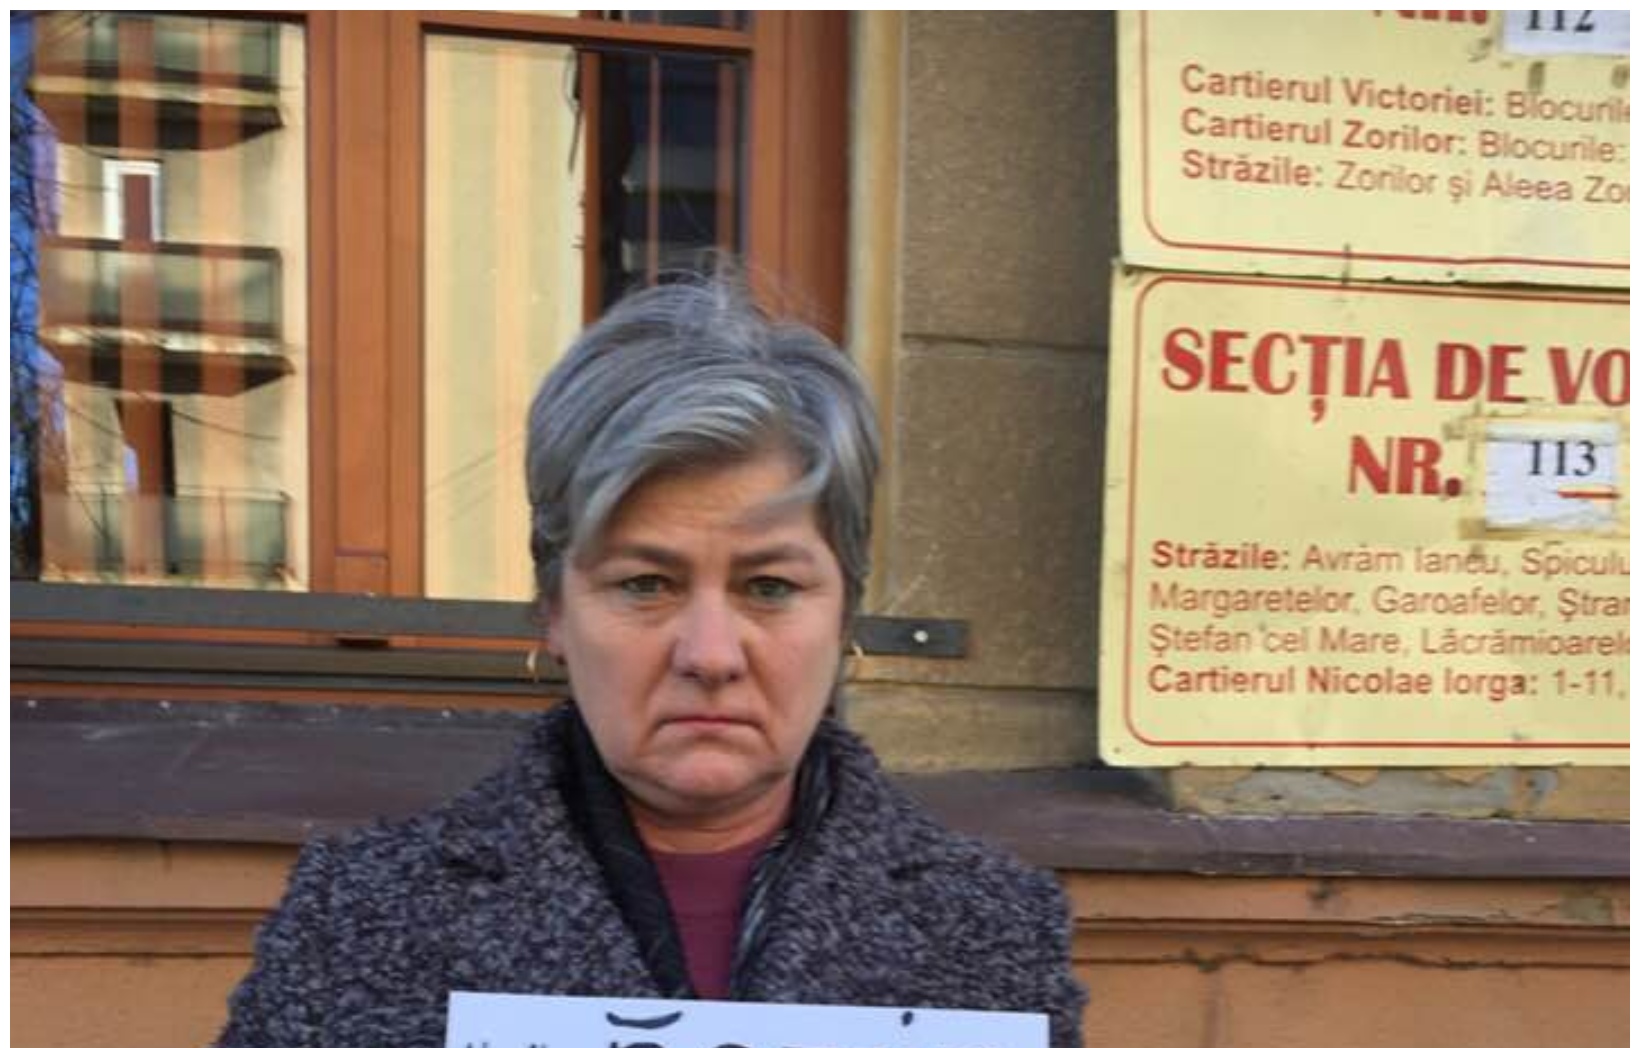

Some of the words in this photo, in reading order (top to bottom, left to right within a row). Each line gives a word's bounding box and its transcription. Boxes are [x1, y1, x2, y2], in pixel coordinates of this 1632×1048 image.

[1181, 63, 1332, 105] Cartierul
[1341, 78, 1494, 117] Victoriei:
[1180, 108, 1332, 147] Cartierul
[1341, 120, 1468, 156] Zorilor:
[1480, 131, 1627, 162] Blocurile:
[1182, 149, 1322, 188] Străzile:
[1335, 160, 1435, 196] Zorilor
[1483, 169, 1573, 201] Aleea
[1584, 175, 1630, 204] Zo
[1433, 341, 1528, 403] DE
[1547, 346, 1630, 407] VO
[1347, 435, 1464, 498] NR.
[1527, 439, 1598, 478] 113
[1151, 540, 1291, 572] Străzile:
[1150, 582, 1360, 618] Margaretelor,
[1371, 585, 1546, 620] Garoafelor,
[1261, 626, 1309, 656] cel
[1319, 627, 1411, 659] Mare,
[1420, 625, 1630, 657] Lăcrămioarel
[1148, 664, 1295, 695] Cartierul
[1306, 665, 1433, 695] Nicolae
[1443, 666, 1538, 702] Iorga:
